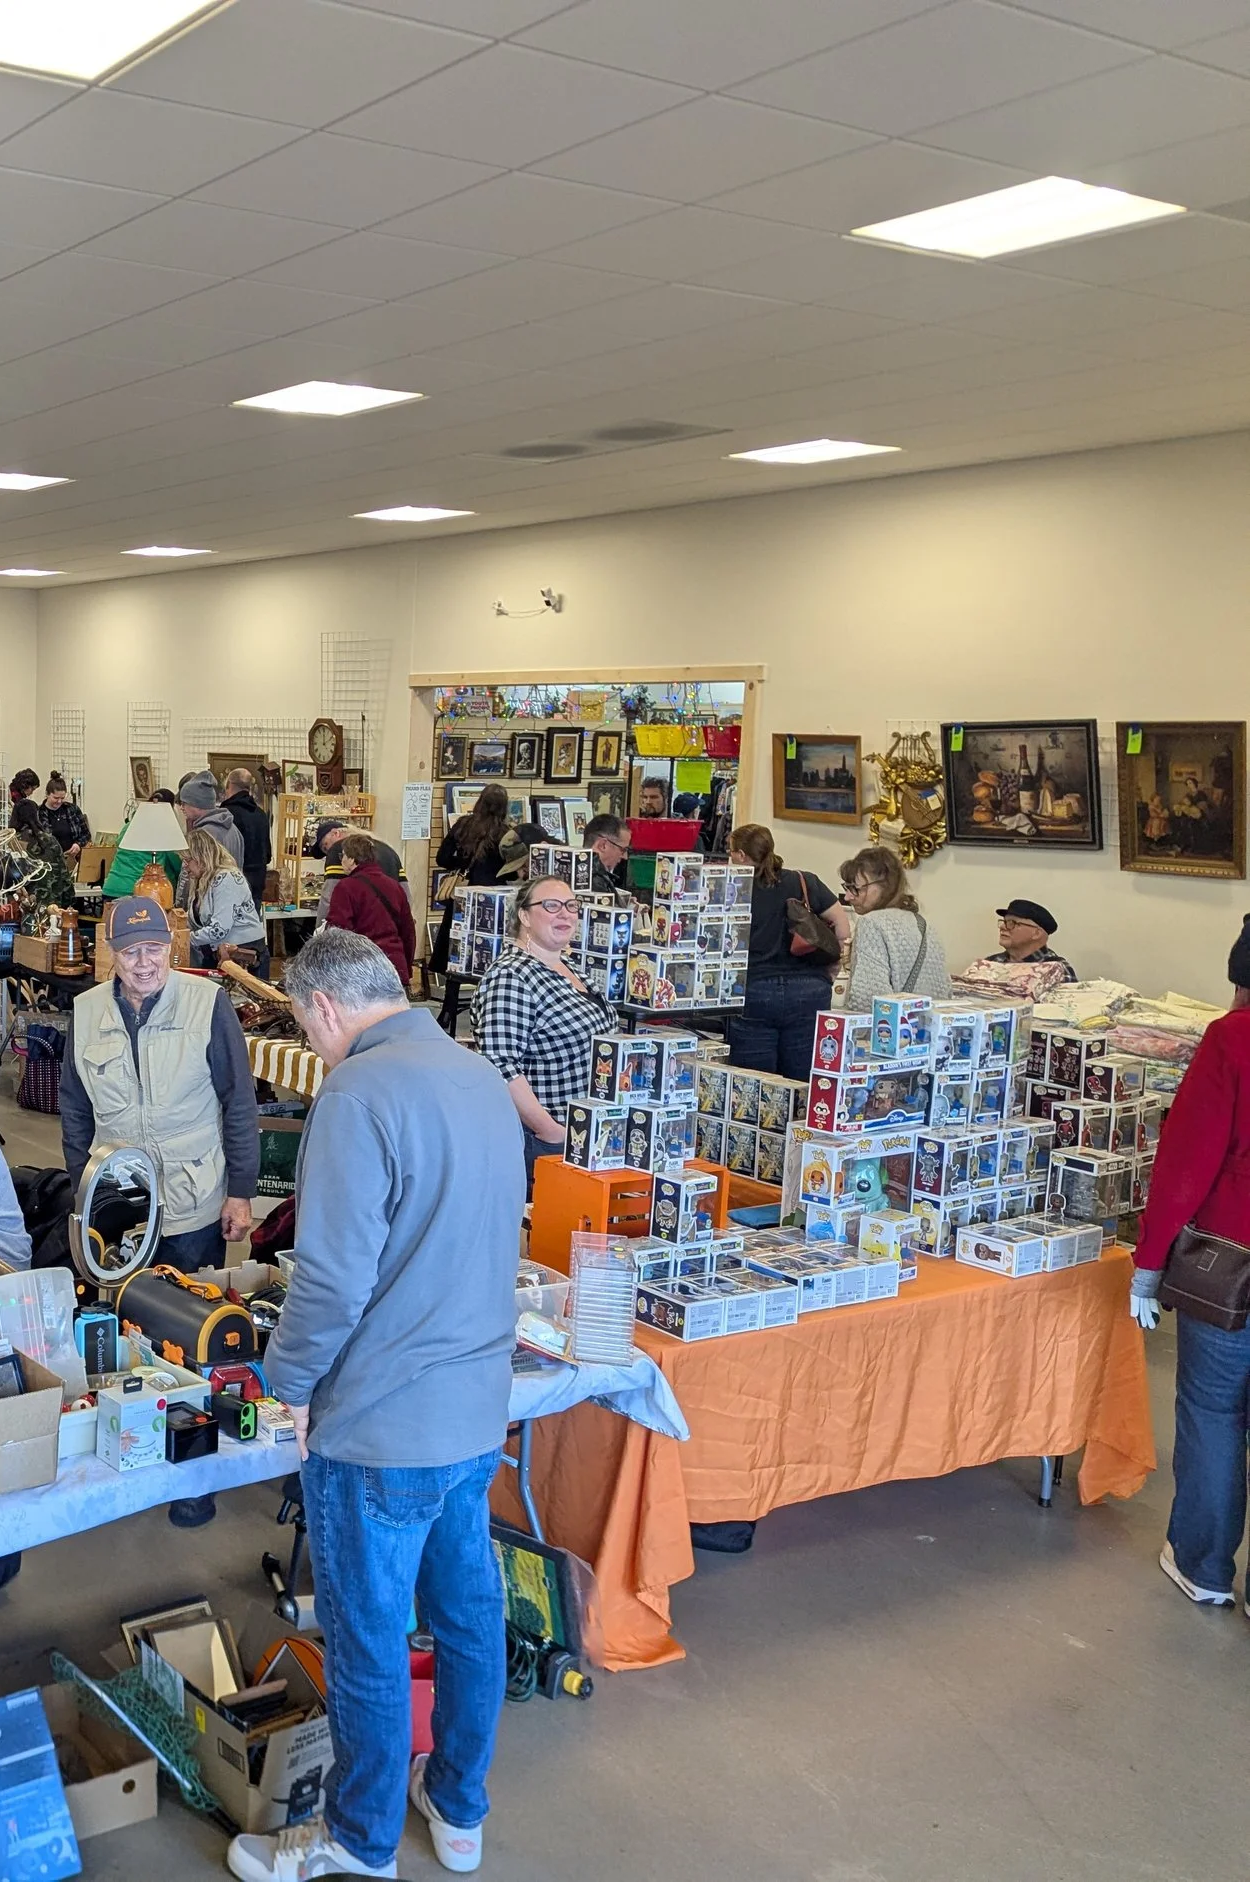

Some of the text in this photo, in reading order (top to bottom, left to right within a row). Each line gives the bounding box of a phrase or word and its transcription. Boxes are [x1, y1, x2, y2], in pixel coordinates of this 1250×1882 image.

[890, 1113, 905, 1122] Disney
[881, 1135, 911, 1152] Pokémon
[257, 1179, 296, 1190] NTENARIO
[97, 1337, 106, 1373] Columbi
